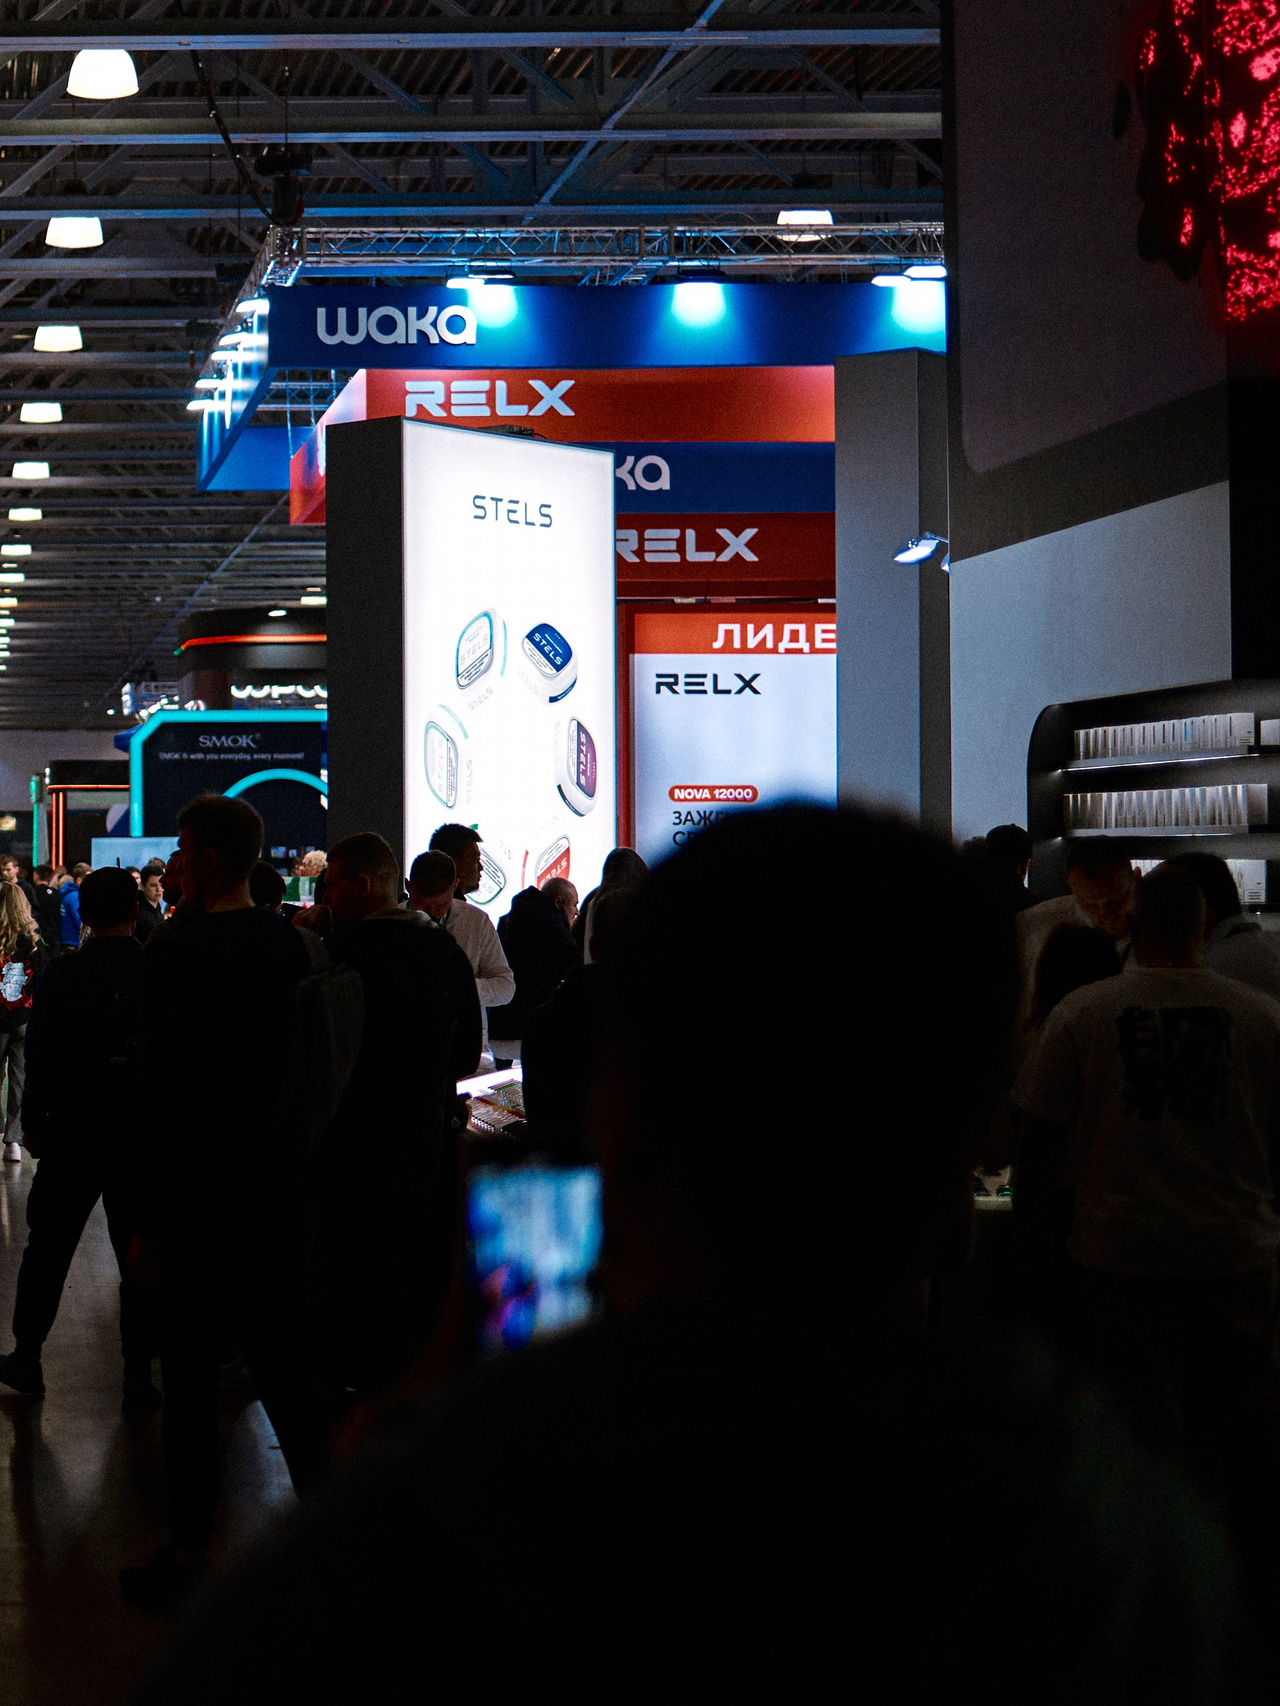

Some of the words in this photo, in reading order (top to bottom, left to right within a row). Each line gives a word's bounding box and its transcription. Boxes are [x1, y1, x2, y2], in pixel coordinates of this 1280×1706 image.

[405, 380, 575, 417] RELX
[472, 494, 553, 528] STELS
[616, 527, 760, 563] RELX
[533, 633, 563, 665] STELS
[655, 673, 761, 695] RELX
[674, 788, 711, 800] NOVA
[713, 788, 753, 800] 12000
